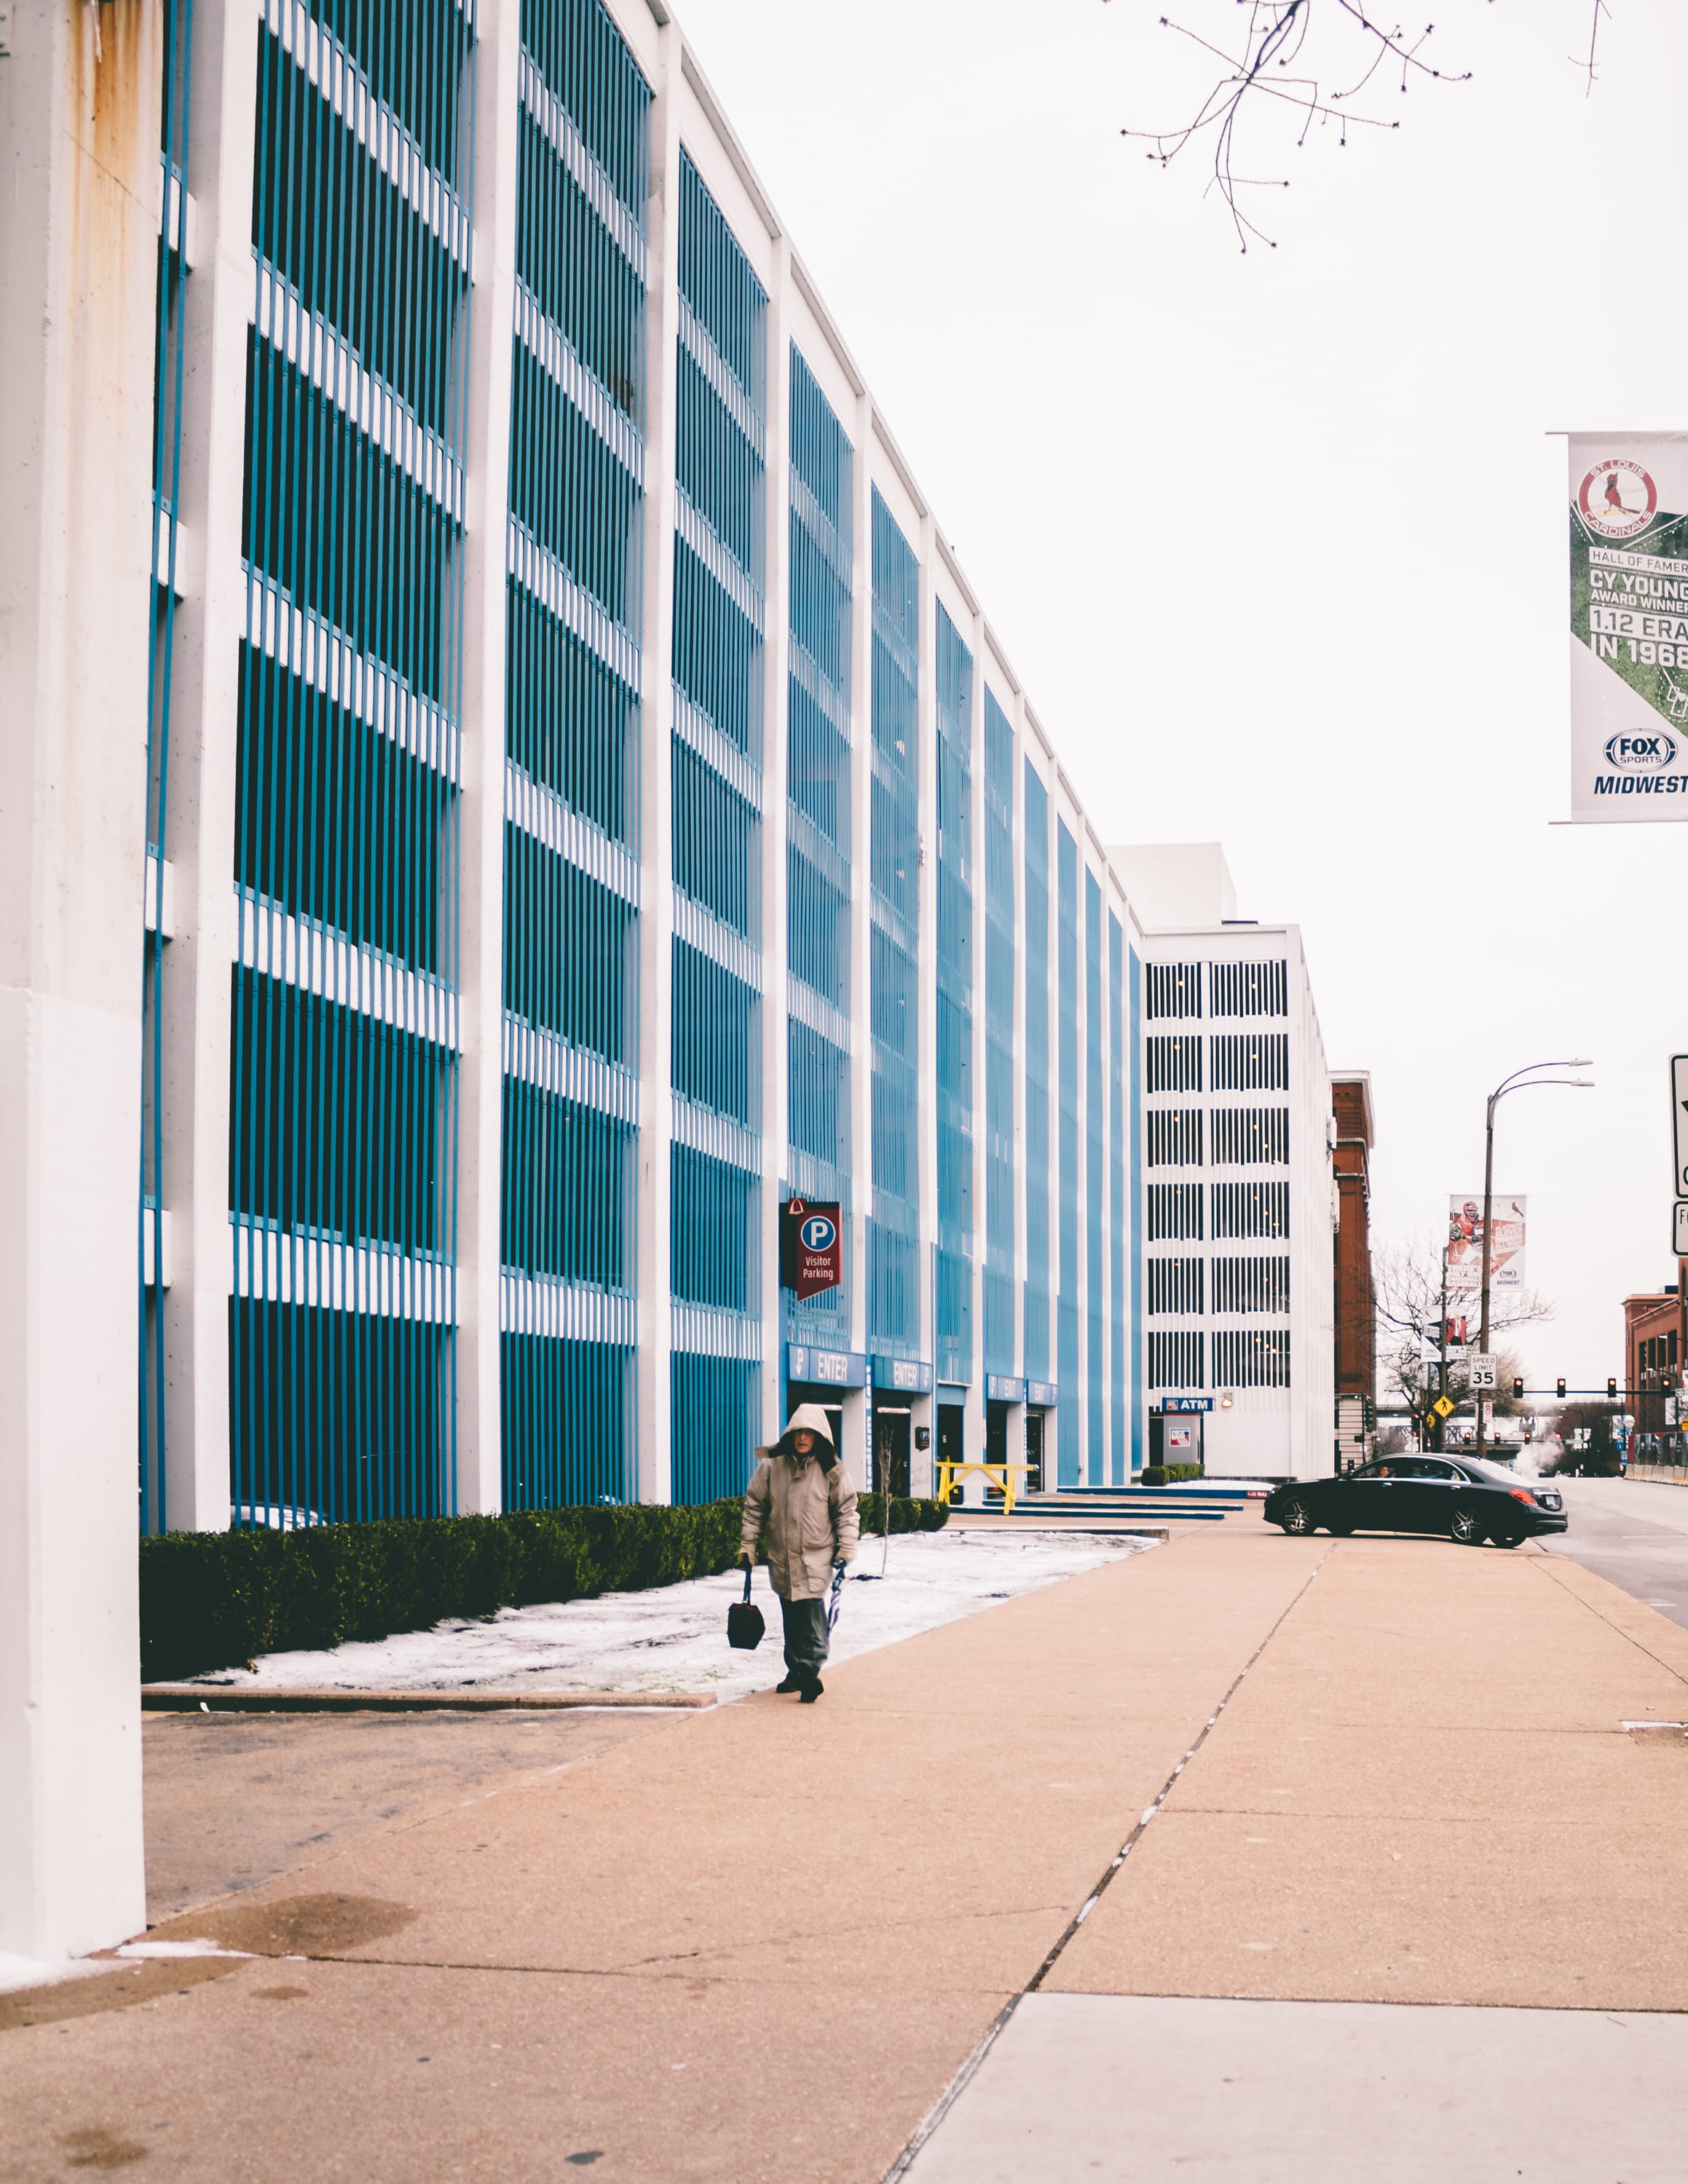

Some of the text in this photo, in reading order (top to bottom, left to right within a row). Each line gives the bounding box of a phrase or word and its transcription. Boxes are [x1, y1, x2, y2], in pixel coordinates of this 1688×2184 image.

[1590, 459, 1646, 478] ST. LOUIS
[1585, 511, 1652, 537] CARDINALS
[1593, 550, 1688, 574] HALL OF FAMER
[1590, 569, 1688, 600] CY YOUNG
[1590, 588, 1637, 606] AWARD
[1593, 609, 1688, 641] 1.12 ERA
[1590, 633, 1688, 670] IN 1968
[1620, 737, 1661, 756] FOX
[1620, 756, 1662, 764] SPORTS
[1593, 775, 1688, 794] MIDWEST
[811, 1221, 829, 1246] P
[805, 1256, 832, 1266] Visitor
[803, 1268, 834, 1281] Parking
[818, 1352, 848, 1382] ENTER
[893, 1361, 918, 1388] ENTER
[1472, 1372, 1494, 1385] 35
[1004, 1379, 1017, 1398] EXIT
[1035, 1384, 1046, 1402] EXIT
[1180, 1399, 1208, 1409] ATM
